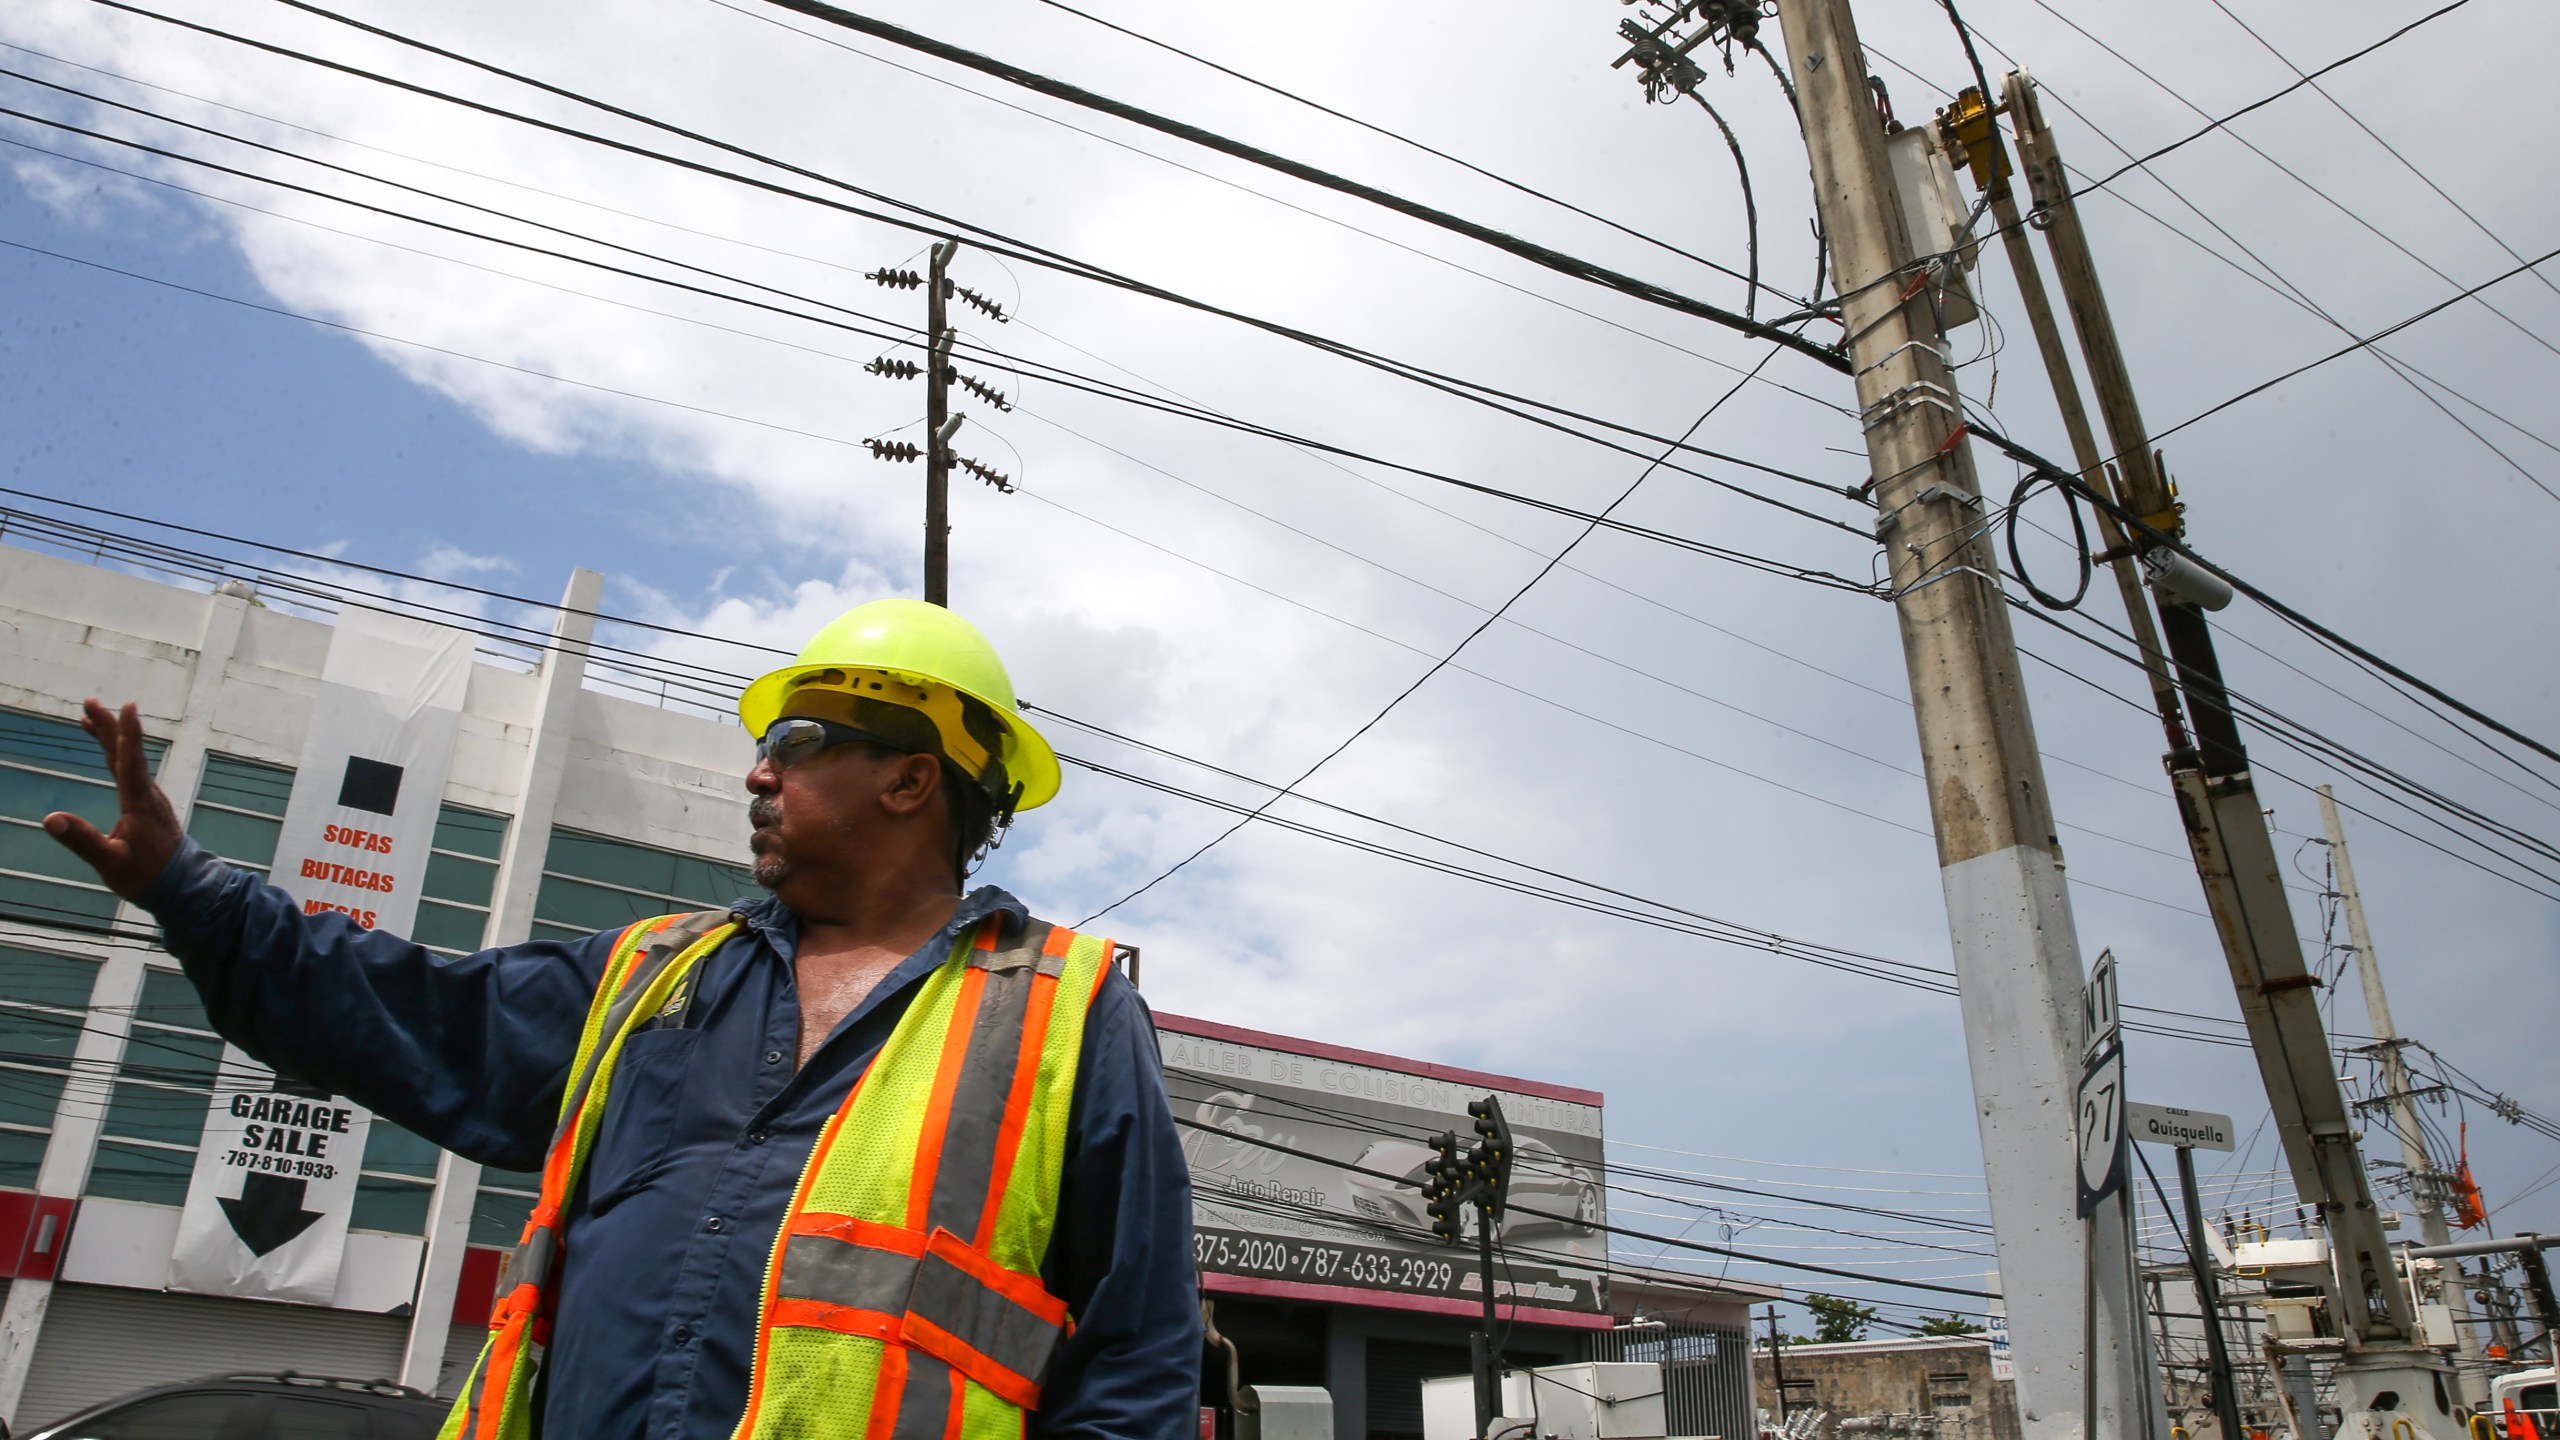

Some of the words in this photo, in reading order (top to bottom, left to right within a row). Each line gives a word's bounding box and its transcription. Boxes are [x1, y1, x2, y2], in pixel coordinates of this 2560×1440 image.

[323, 824, 393, 854] SOFAS
[300, 858, 394, 893] BUTACAS
[1160, 1032, 1252, 1076] TALLER
[1270, 1060, 1304, 1085] DE
[1320, 1068, 1449, 1110] COLISION
[230, 1094, 352, 1133] GARAGE
[2166, 1107, 2189, 1117] CALLE
[243, 1124, 328, 1158] SALE
[2148, 1118, 2224, 1143] Quisquella
[1224, 1175, 1267, 1199] Auto
[1269, 1179, 1326, 1207] Repair
[1300, 1246, 1452, 1291] 787-633-2929
